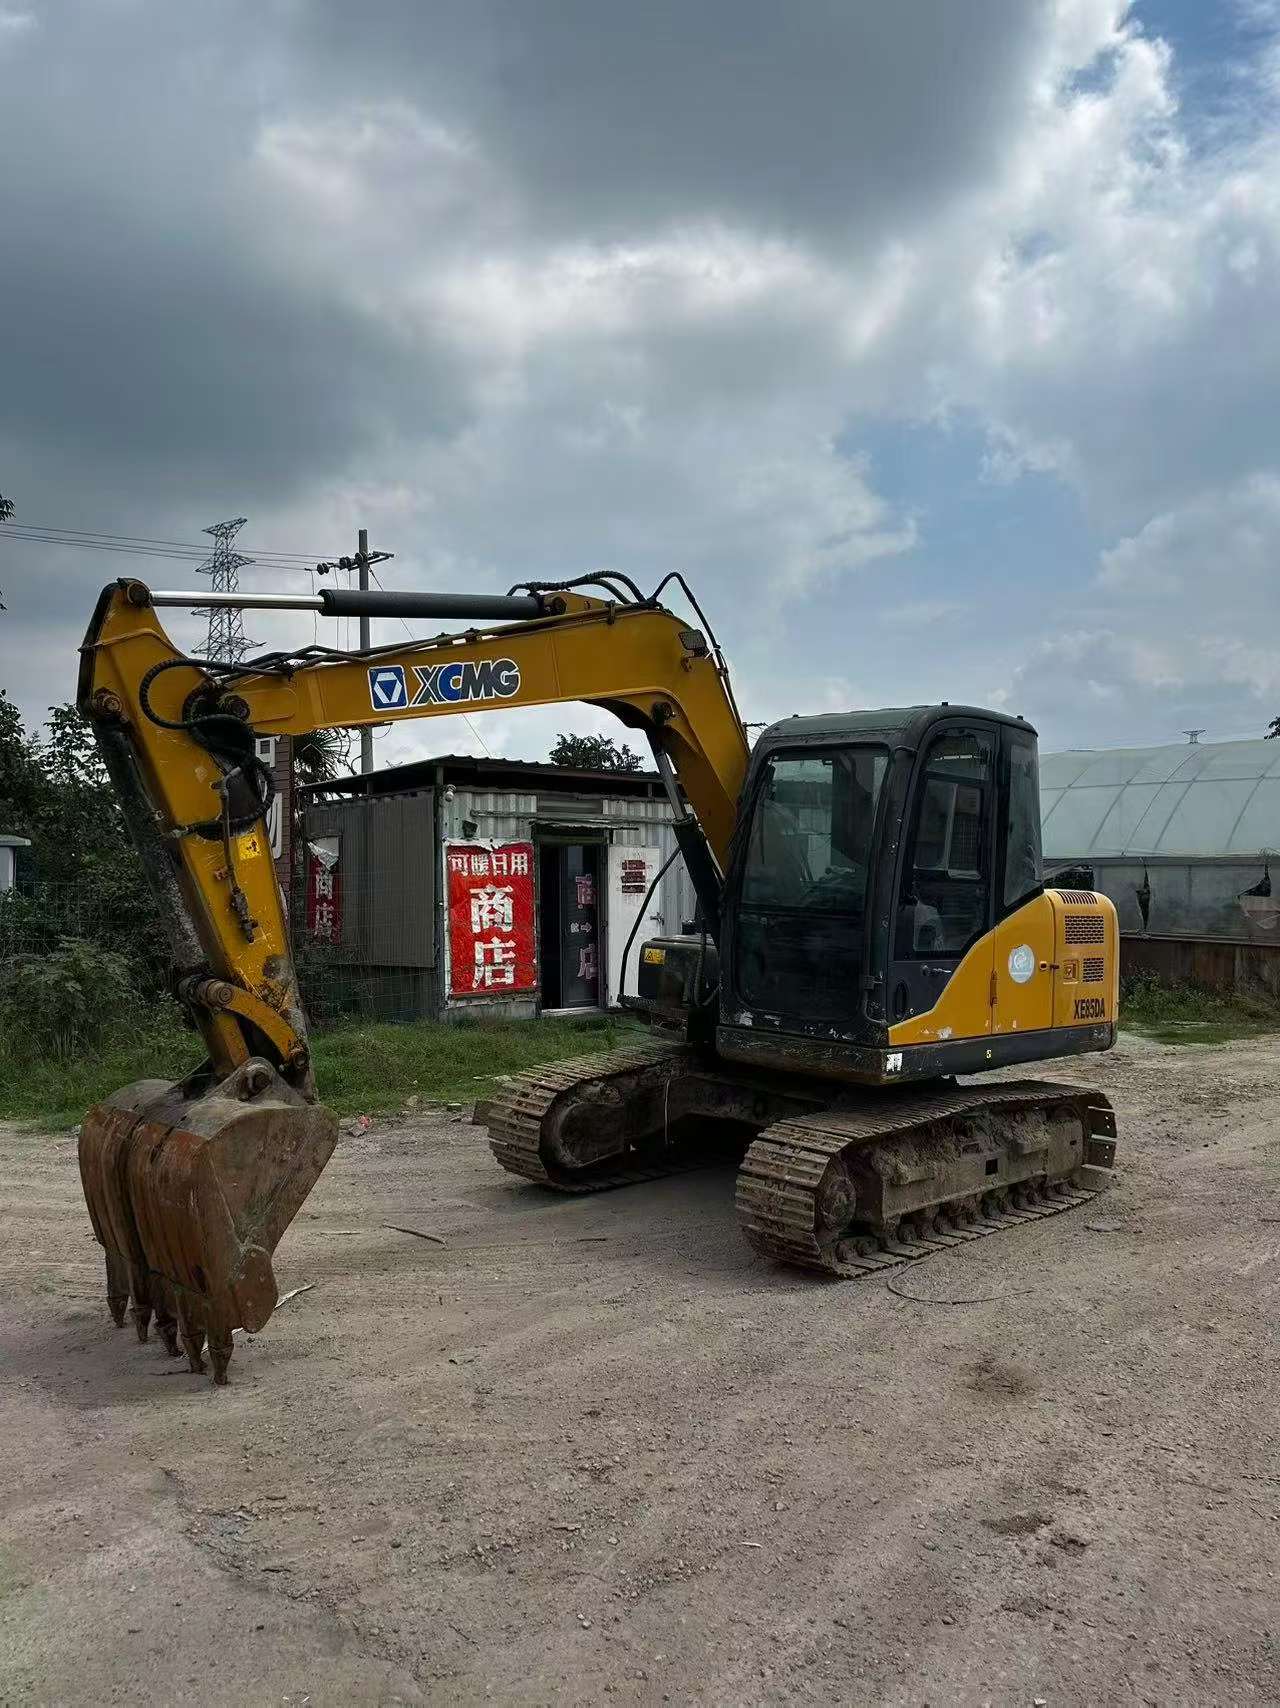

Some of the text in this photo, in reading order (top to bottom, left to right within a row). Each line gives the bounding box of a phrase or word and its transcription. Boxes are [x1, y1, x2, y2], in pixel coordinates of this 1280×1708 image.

[409, 658, 521, 707] XCMG
[469, 883, 517, 988] 商店
[1073, 997, 1106, 1019] XE85DA
